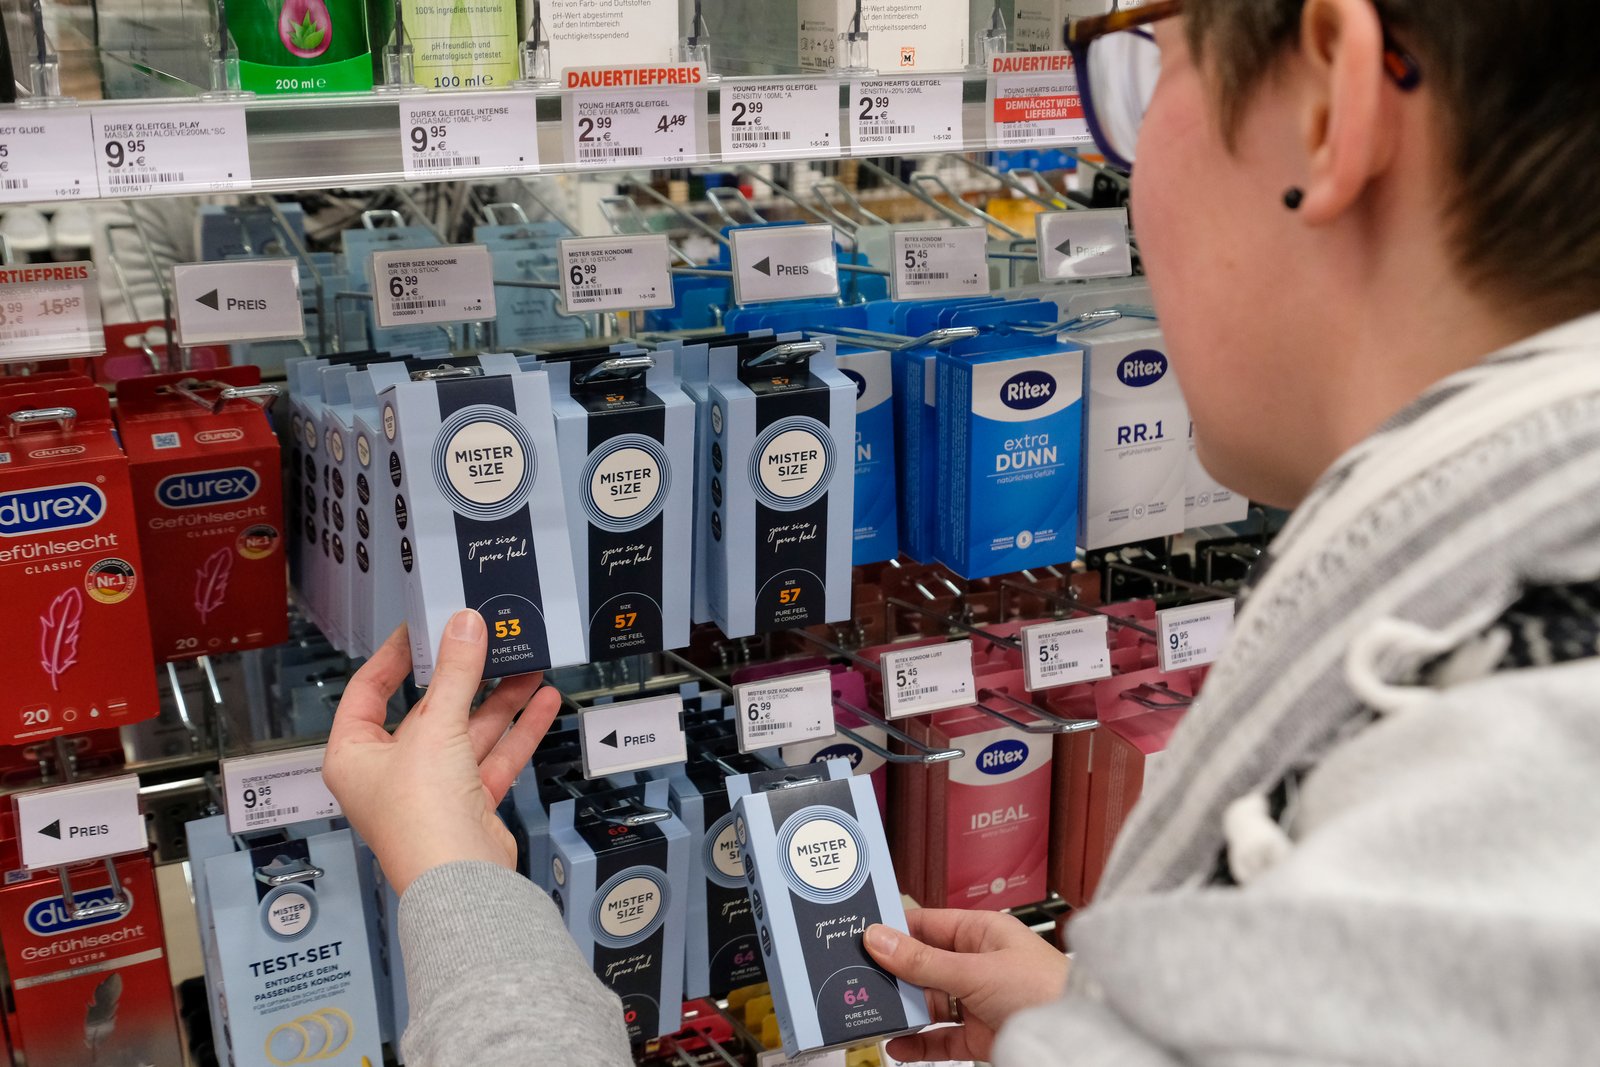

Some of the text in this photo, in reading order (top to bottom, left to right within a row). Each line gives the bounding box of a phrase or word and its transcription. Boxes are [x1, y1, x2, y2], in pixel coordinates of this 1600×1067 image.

[416, 6, 434, 14] 100%
[886, 4, 922, 13] abgestimmt
[552, 12, 624, 20] pH-Wert abgestimmt
[884, 12, 919, 20] Intimbereich
[580, 20, 620, 28] Intimbereich
[552, 32, 630, 41] feuchtigkeitsspendend
[422, 51, 501, 62] dermatologisch getestet
[276, 78, 314, 90] 200 ml
[434, 75, 480, 88] 100 ml
[567, 66, 701, 88] DAUERTIEFPREIS
[579, 102, 604, 110] YOUNG
[636, 100, 670, 108] GLEITGEL
[1006, 98, 1082, 110] DEMNÄCHST WIEDE
[410, 110, 437, 118] DUREX
[438, 108, 476, 117] GLEITGEL
[599, 108, 618, 116] VERA
[1025, 108, 1067, 118] LIEFERBAR
[104, 124, 133, 132] DUREX
[136, 122, 178, 131] GLEITGEL
[410, 117, 452, 125] ORGASMIC
[19, 126, 46, 134] GLIDE
[568, 250, 590, 258] MISTER
[605, 248, 633, 256] KONDOME
[412, 260, 426, 268] SIZE
[418, 266, 440, 274] STÜCK
[776, 264, 809, 276] PREIS
[0, 266, 88, 284] RTIEFPREIS
[227, 298, 267, 310] PREIS
[1124, 360, 1162, 378] Ritex
[1007, 382, 1050, 401] Ritex
[1118, 420, 1164, 445] RR.1
[1004, 434, 1049, 451] extra
[455, 446, 514, 464] MISTER
[768, 450, 818, 465] MISTER
[996, 446, 1058, 472] DÜNN
[468, 462, 504, 478] SIZE
[600, 468, 652, 484] MISTER
[778, 464, 808, 476] SIZE
[996, 468, 1056, 485] natürliches Gefühl
[166, 476, 251, 500] durex
[610, 482, 641, 496] SIZE
[0, 494, 98, 526] durex
[148, 506, 267, 529] Gefühlsecht
[186, 526, 235, 538] CLASSIC
[0, 533, 118, 562] efühlsecht
[468, 536, 518, 560] your size
[479, 539, 528, 574] pure feel
[25, 560, 82, 574] CLASSIC
[780, 588, 801, 604] 57
[498, 608, 511, 616] SIZE
[776, 606, 806, 616] PURE FEEL
[780, 614, 808, 622] CONDOMS
[614, 612, 638, 629] 57
[494, 618, 522, 638] 53
[176, 638, 198, 649] 20
[492, 644, 532, 655] PURE FEEL
[616, 640, 646, 648] CONDOMS
[500, 652, 534, 662] CONDOMS
[910, 654, 930, 662] KONDOM
[23, 708, 48, 724] 20
[624, 733, 656, 748] PREIS
[982, 748, 1024, 768] Ritex
[264, 766, 322, 780] KONDOM GEFÜHLSE
[970, 804, 1030, 830] IDEAL
[69, 824, 109, 839] PREIS
[608, 826, 628, 836] 60
[796, 838, 847, 857] MISTER
[810, 852, 841, 868] SIZE
[608, 892, 654, 912] MISTER
[273, 903, 306, 917] MISTER
[616, 904, 644, 920] SIZE
[280, 912, 300, 923] SIZE
[20, 925, 144, 960] Gefühlsecht
[70, 952, 106, 965] ULTRA
[249, 941, 342, 978] TEST-SET
[734, 950, 754, 966] 64
[265, 964, 338, 990] ENTDECKE DEIN
[254, 970, 352, 1002] PASSENDES KONDOM
[844, 987, 869, 1005] 64
[844, 1008, 880, 1020] PURE FEEL
[852, 1016, 882, 1026] CONDOMS
